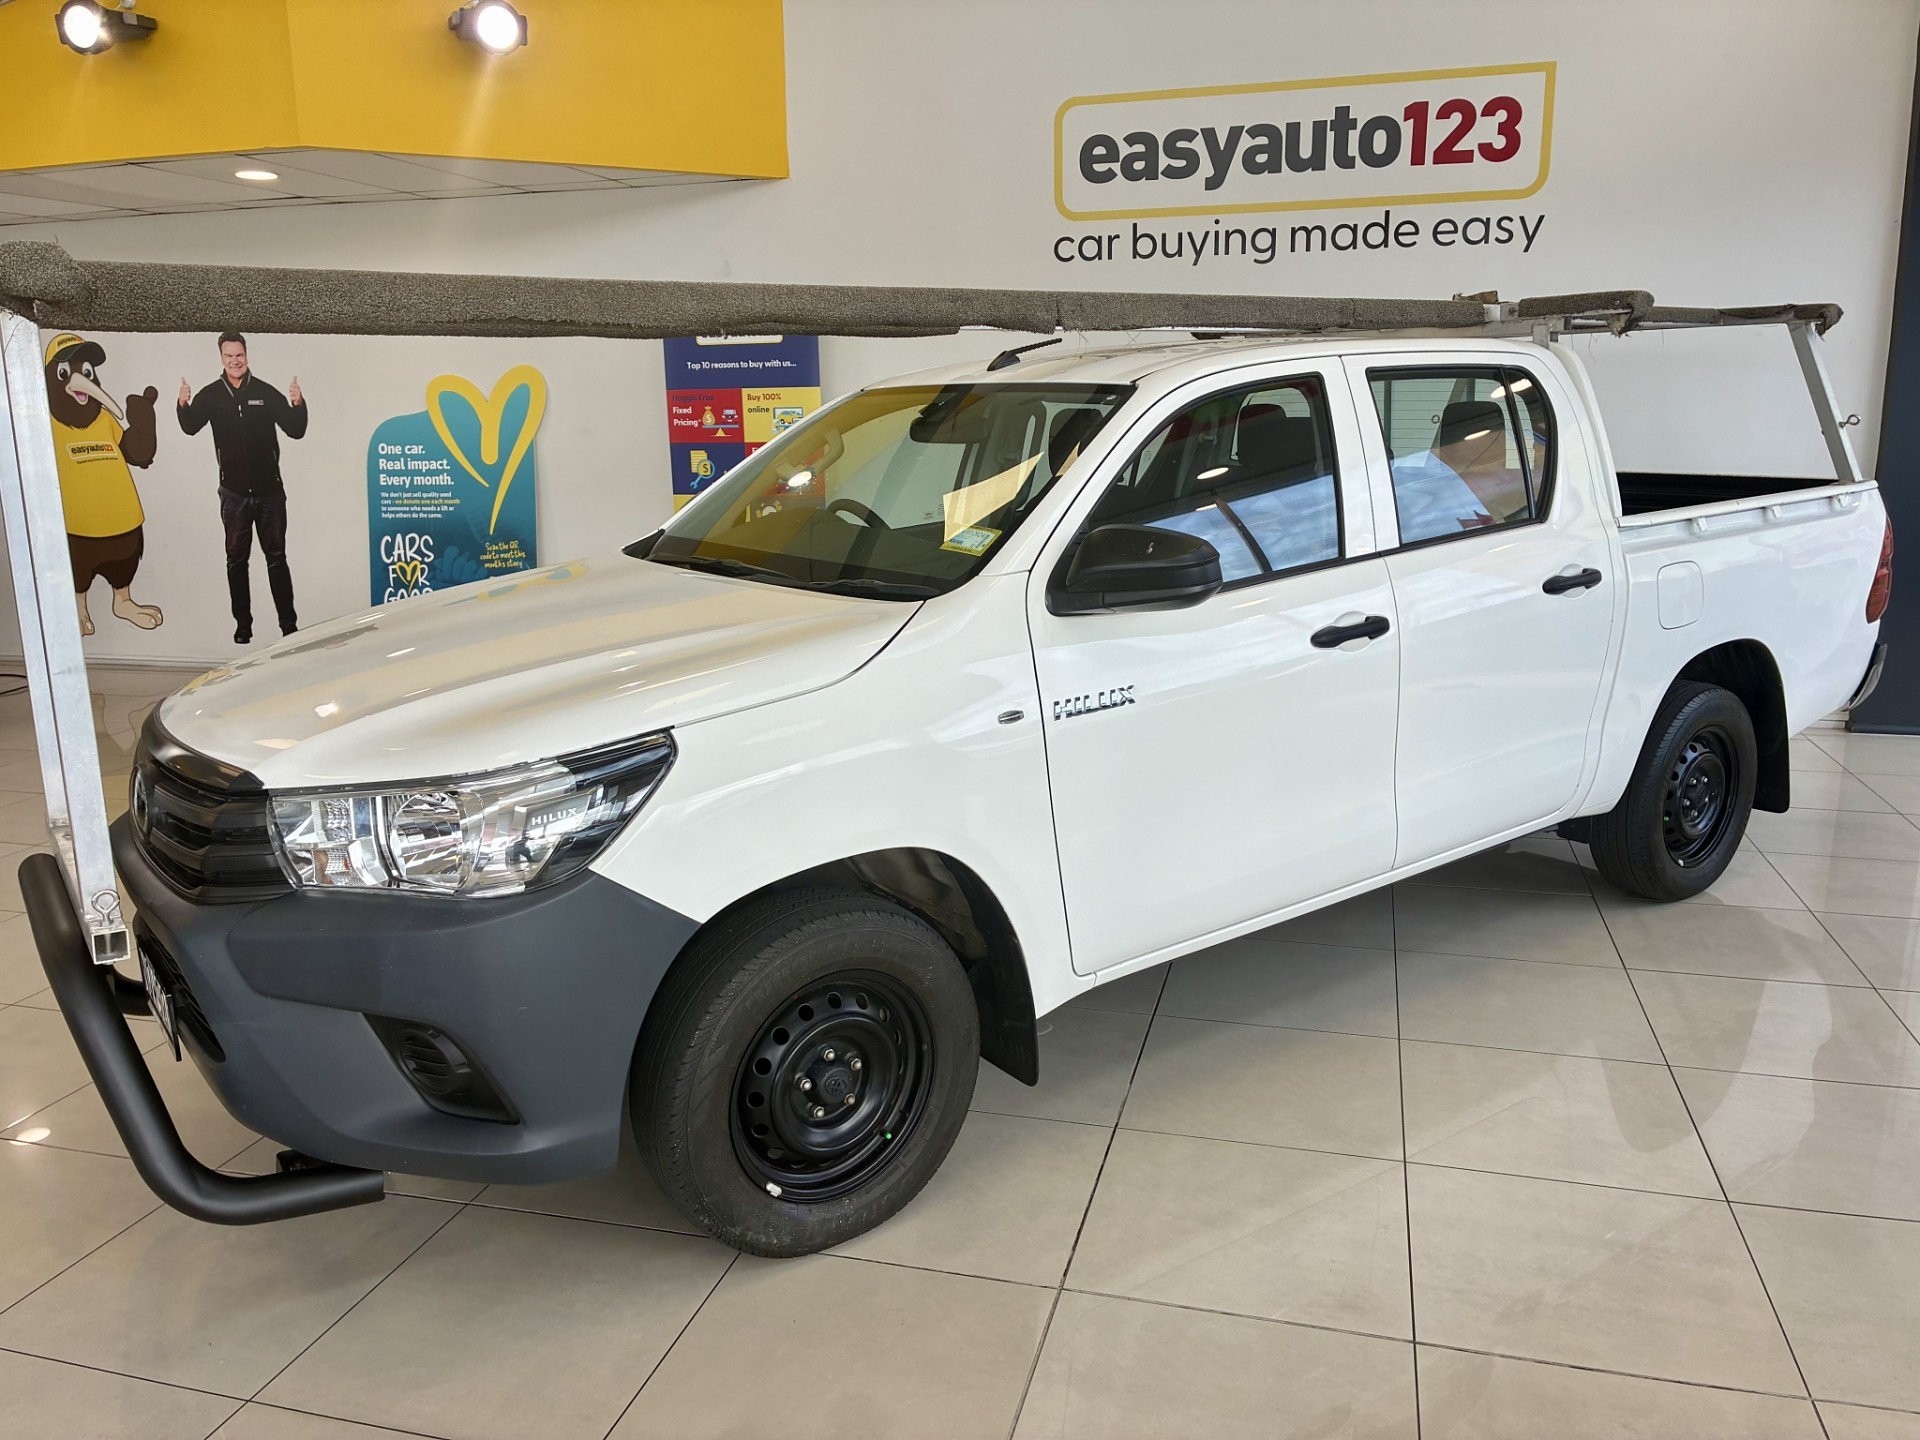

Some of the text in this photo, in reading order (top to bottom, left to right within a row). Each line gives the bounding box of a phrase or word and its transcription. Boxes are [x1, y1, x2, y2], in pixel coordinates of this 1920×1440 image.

[1079, 95, 1523, 191] easyauto123
[1053, 210, 1545, 266] car buying made easy
[686, 361, 701, 371] Top
[701, 361, 710, 369] 10
[711, 361, 740, 369] reasons
[740, 360, 748, 368] to
[749, 360, 763, 369] buy
[764, 359, 781, 368] with
[747, 393, 782, 402] Buy 100%
[672, 406, 692, 414] Fixed
[378, 442, 426, 455] One car.
[379, 457, 451, 473] Real impact.
[379, 472, 455, 489] Every month.
[402, 491, 412, 499] just
[422, 491, 439, 499] quality
[380, 532, 435, 563] CARS
[1053, 684, 1136, 721] HILUX
[531, 807, 580, 826] HILUX
